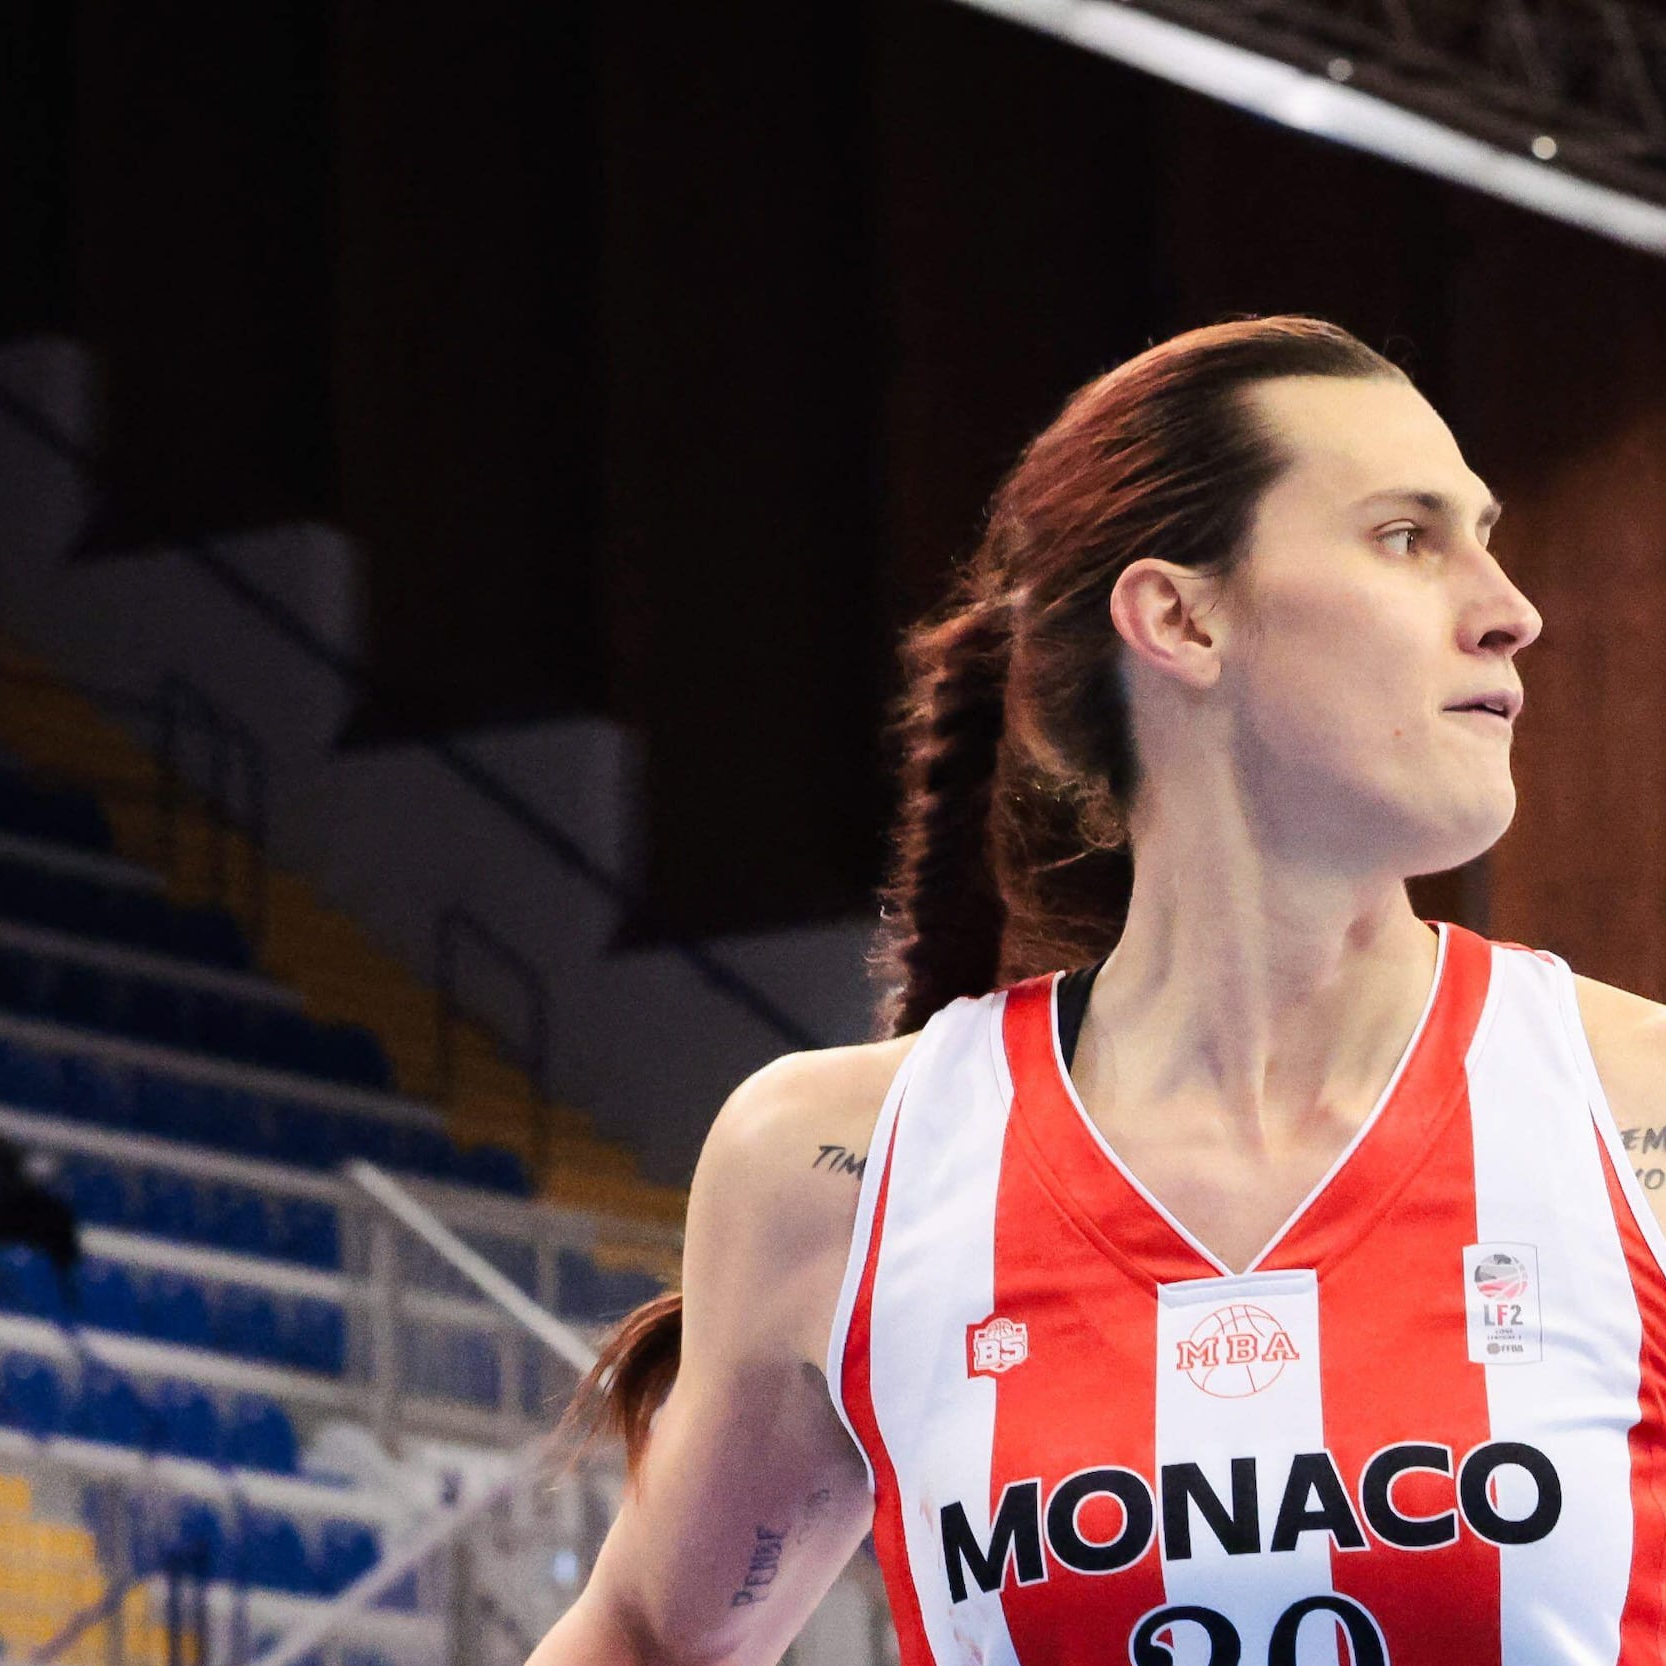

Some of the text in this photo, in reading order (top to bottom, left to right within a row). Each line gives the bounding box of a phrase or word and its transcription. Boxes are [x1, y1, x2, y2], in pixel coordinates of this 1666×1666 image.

[1483, 1303, 1524, 1327] LF2
[1176, 1332, 1300, 1370] MBA
[940, 1441, 1564, 1604] MONACO
